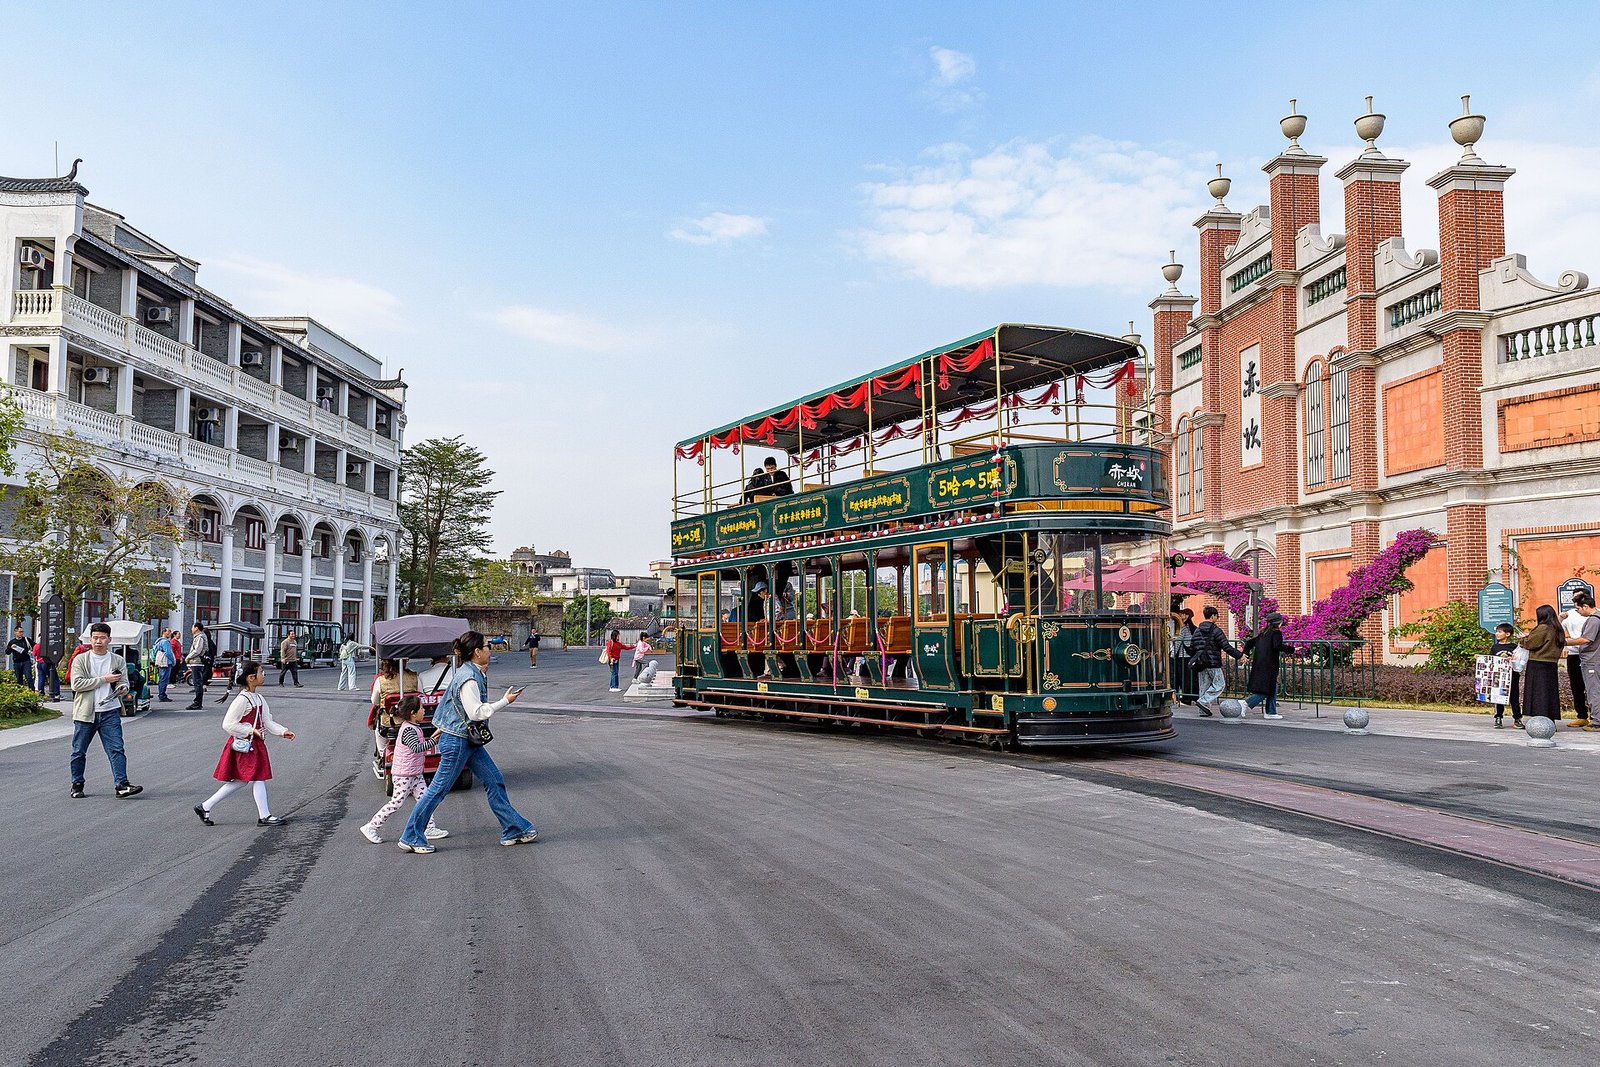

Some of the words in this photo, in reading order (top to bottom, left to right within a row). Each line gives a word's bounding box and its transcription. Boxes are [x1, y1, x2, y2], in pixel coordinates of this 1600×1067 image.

[1242, 361, 1261, 450] 赤坎
[1108, 463, 1143, 482] 赤坎
[939, 475, 961, 497] 5哈
